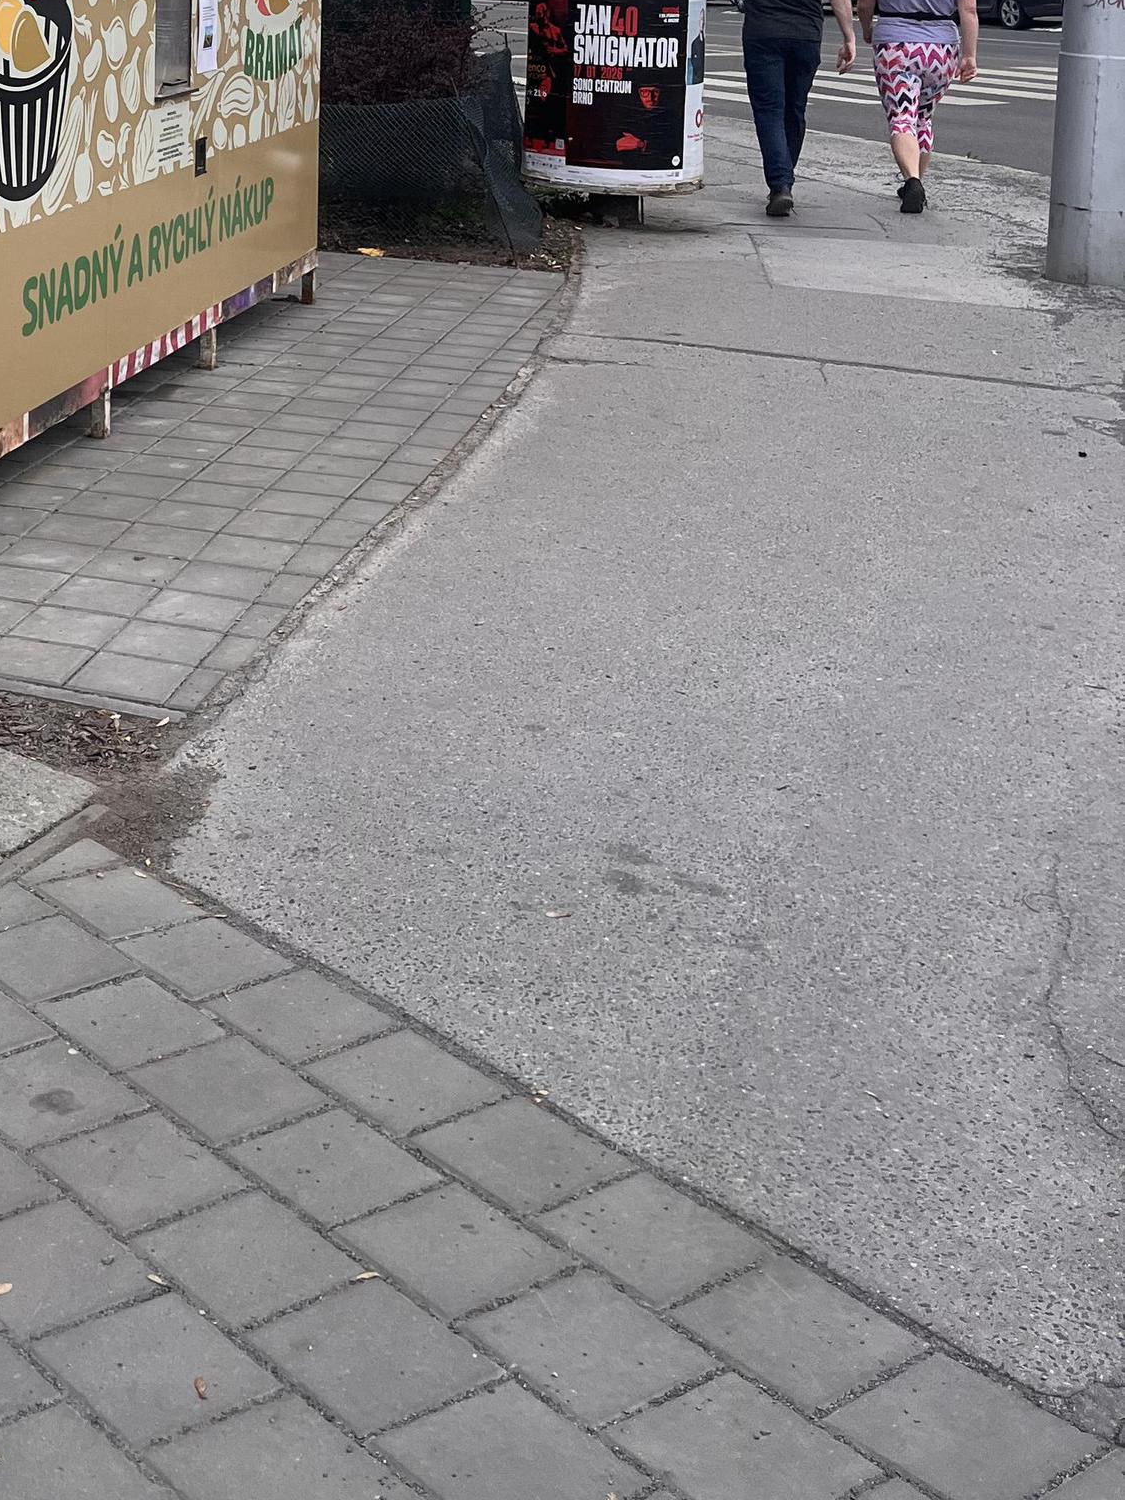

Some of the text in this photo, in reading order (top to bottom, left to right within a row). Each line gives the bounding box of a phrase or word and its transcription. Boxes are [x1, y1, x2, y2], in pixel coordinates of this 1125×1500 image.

[244, 15, 302, 81] BRAMAT
[573, 34, 679, 69] SMIGMATOR
[572, 91, 593, 106] BRNO
[573, 77, 632, 94] SONO CENTRUM
[22, 175, 275, 337] SNADNÝ A RYCHLÝ NÁKUP
